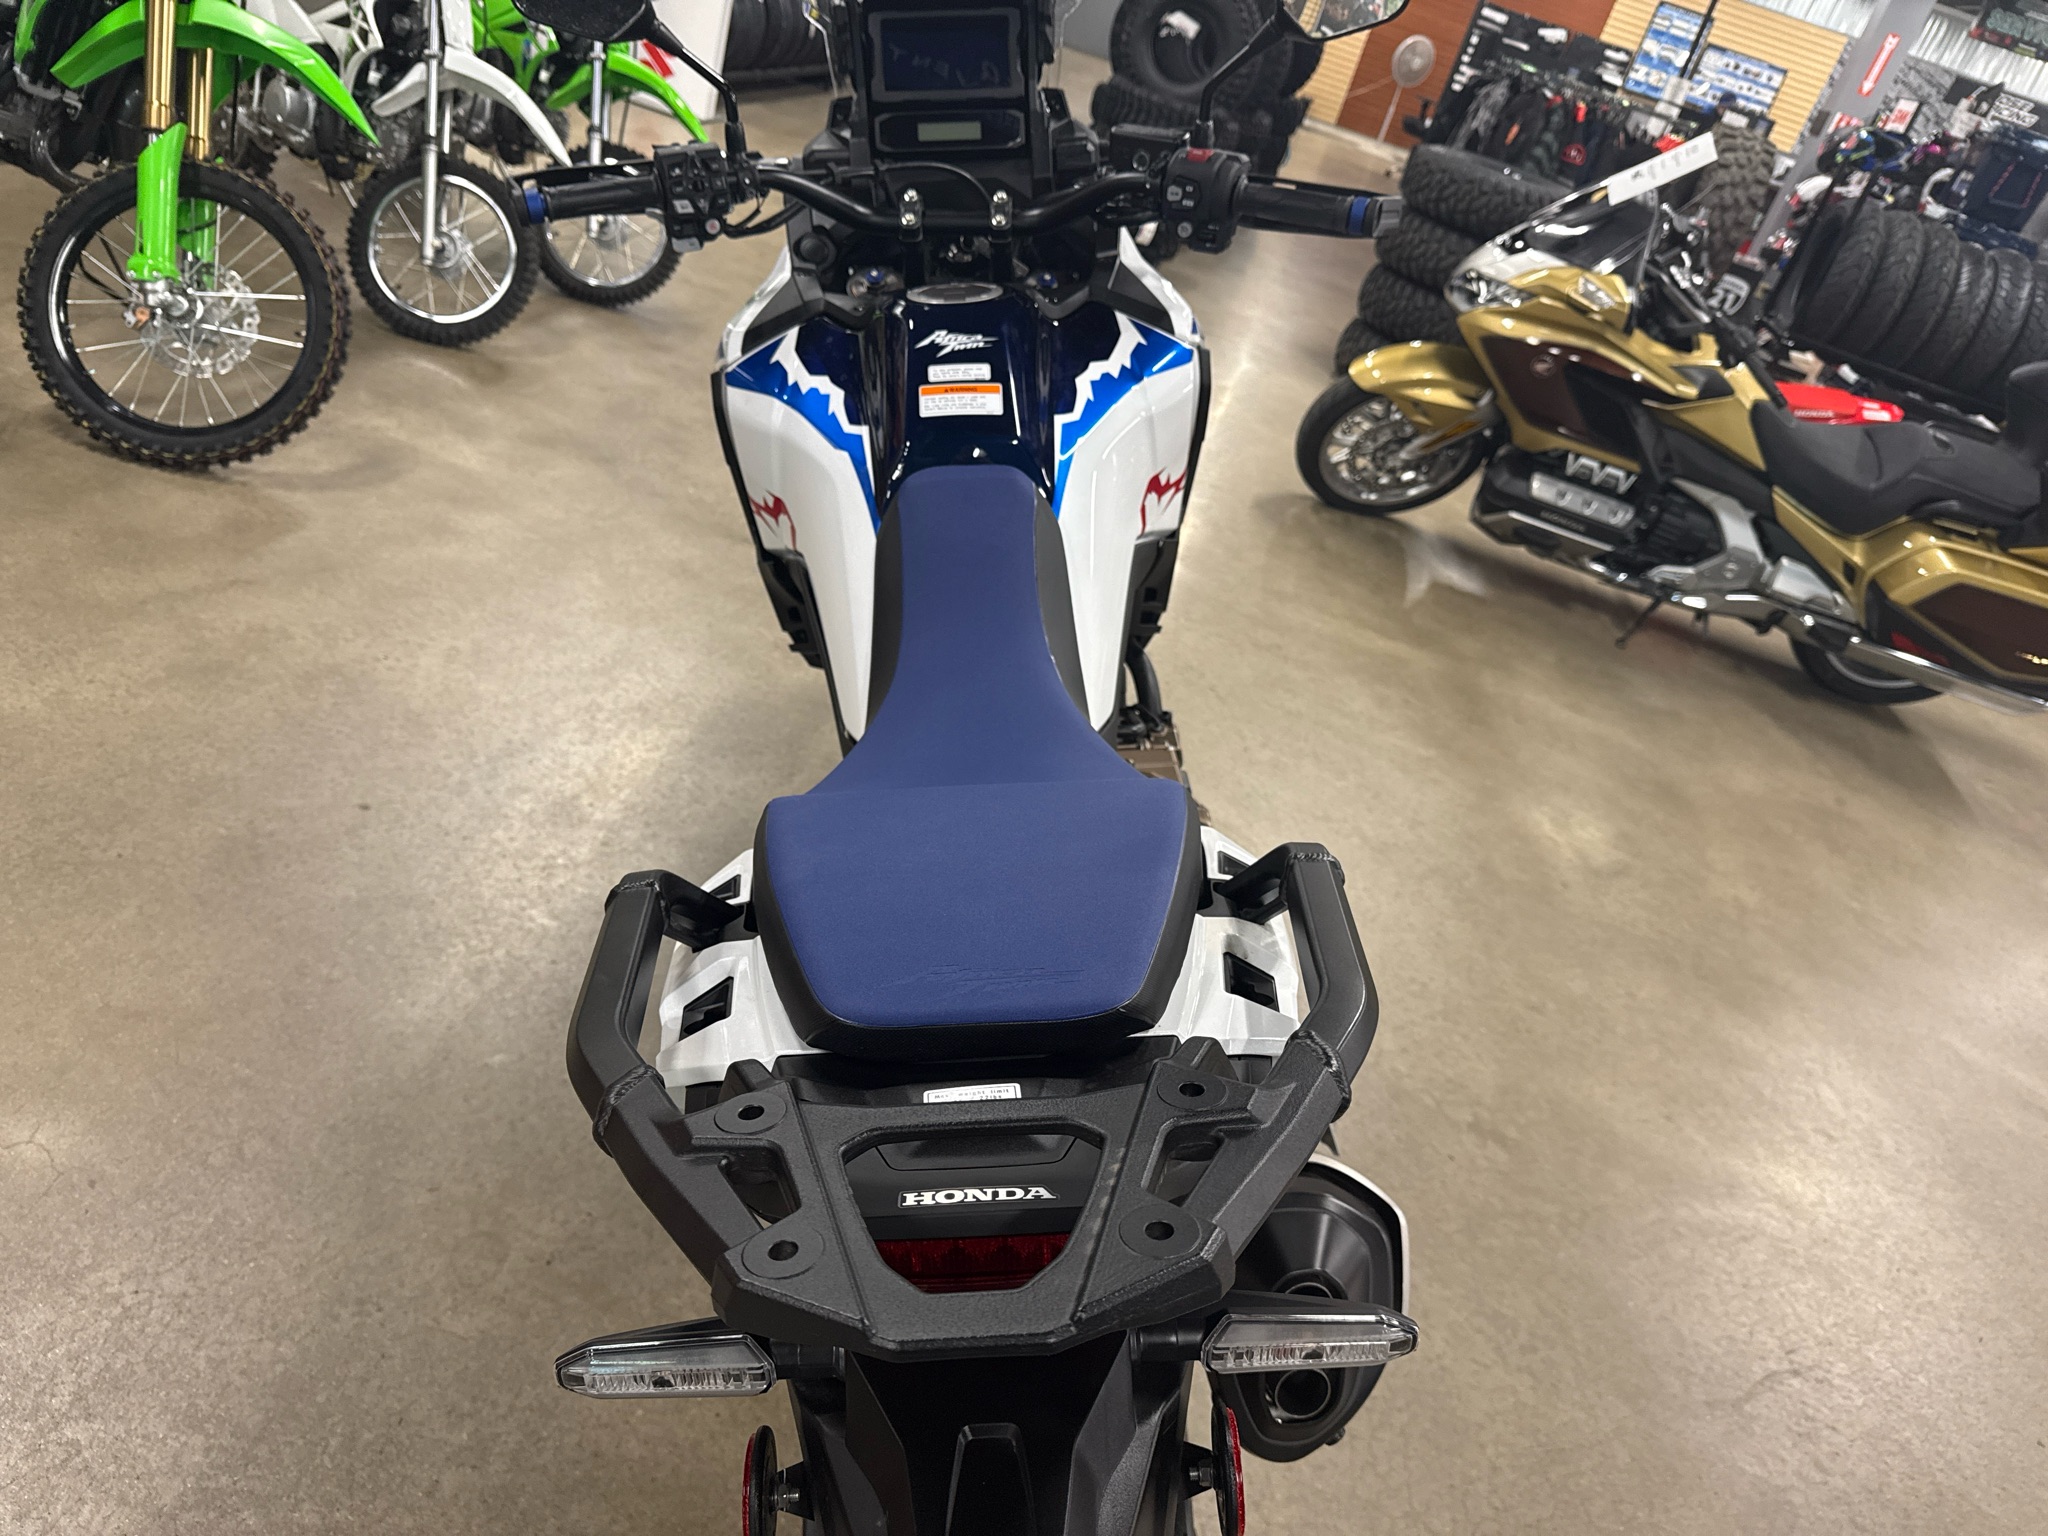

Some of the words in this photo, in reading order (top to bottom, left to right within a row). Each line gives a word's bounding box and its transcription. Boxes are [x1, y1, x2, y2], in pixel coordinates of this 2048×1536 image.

[914, 329, 999, 349] Africa
[936, 341, 994, 359] Twin
[901, 1186, 1057, 1207] HONDA
